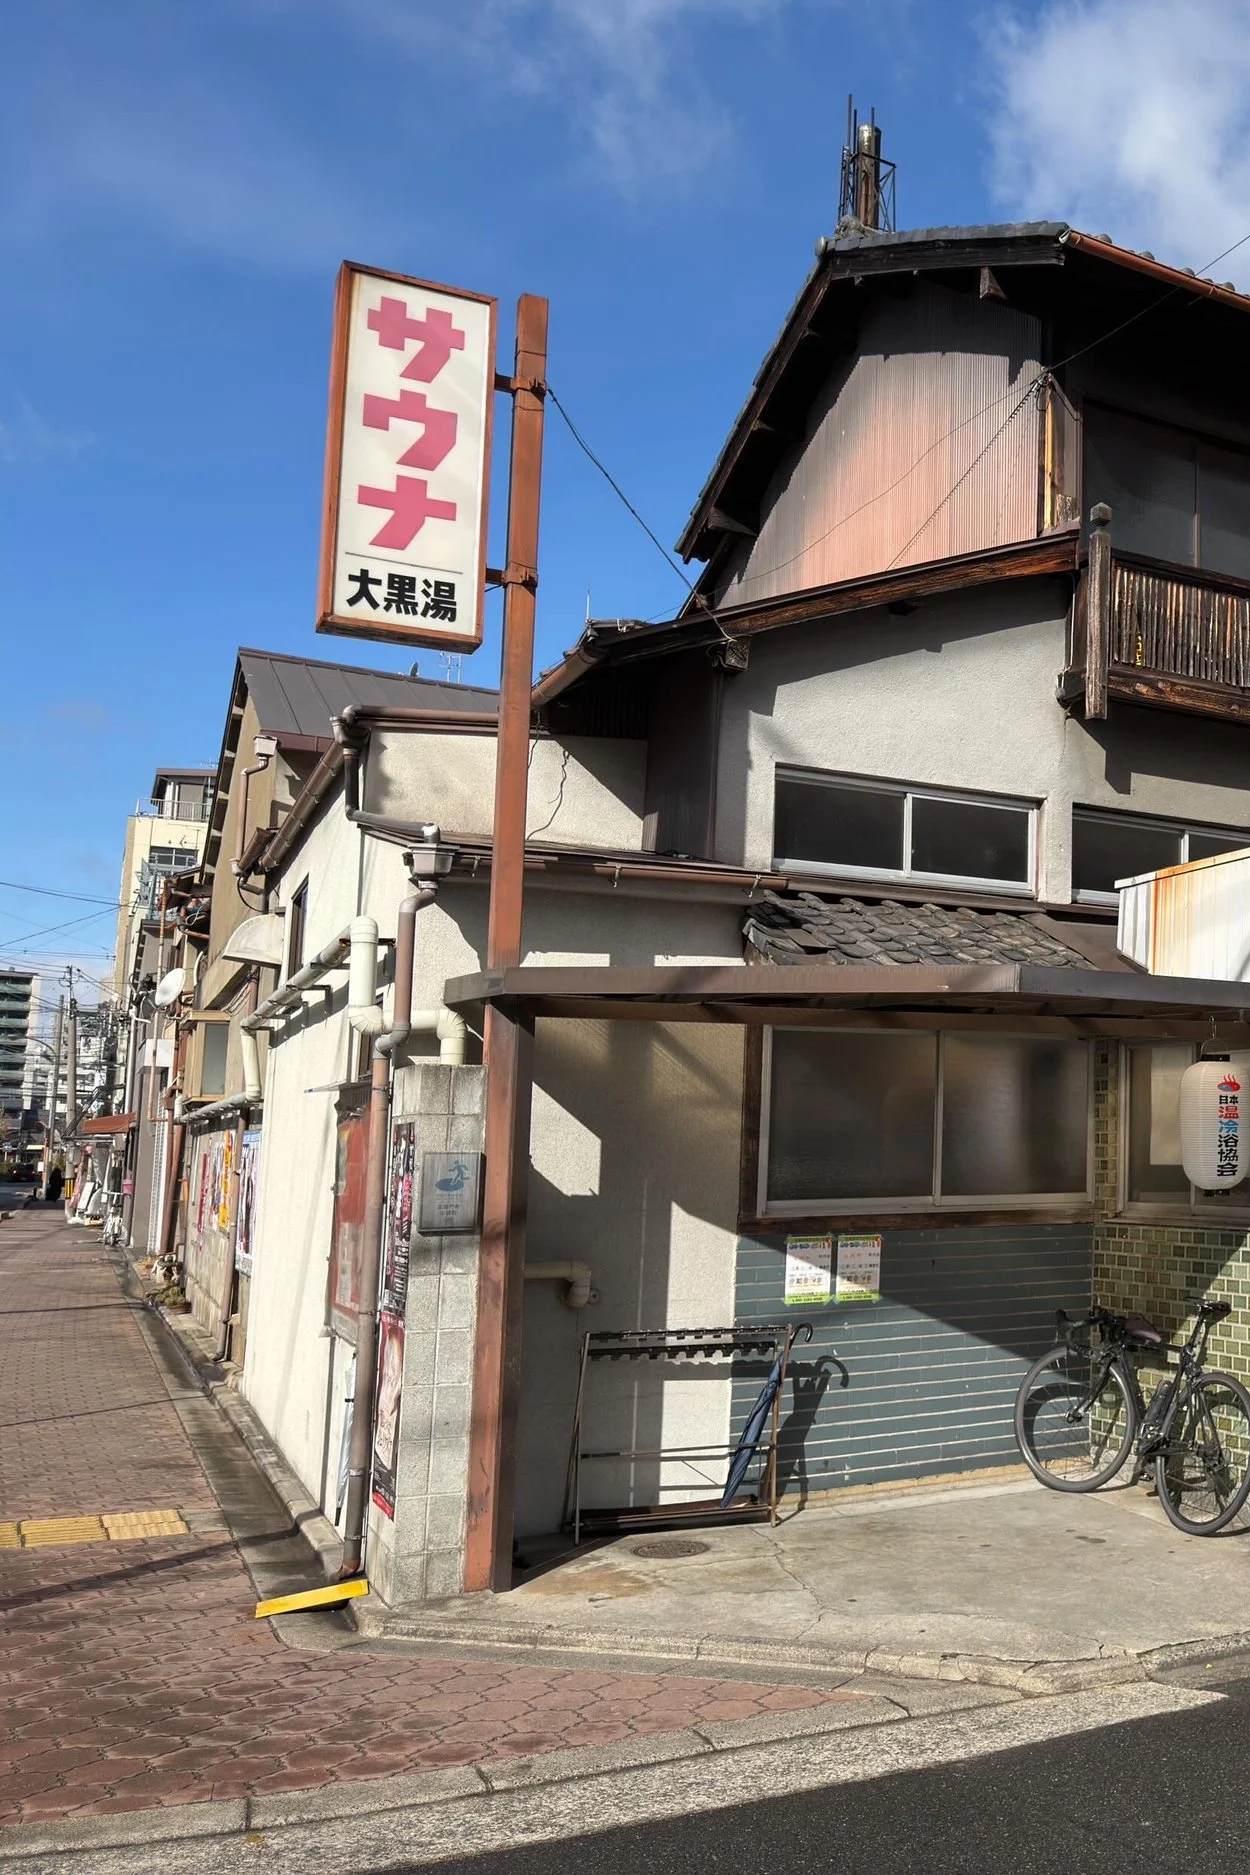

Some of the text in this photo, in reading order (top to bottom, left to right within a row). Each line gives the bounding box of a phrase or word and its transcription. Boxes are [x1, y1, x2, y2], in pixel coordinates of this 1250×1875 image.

[357, 296, 465, 551] サウナ
[346, 568, 458, 623] 大黒湯
